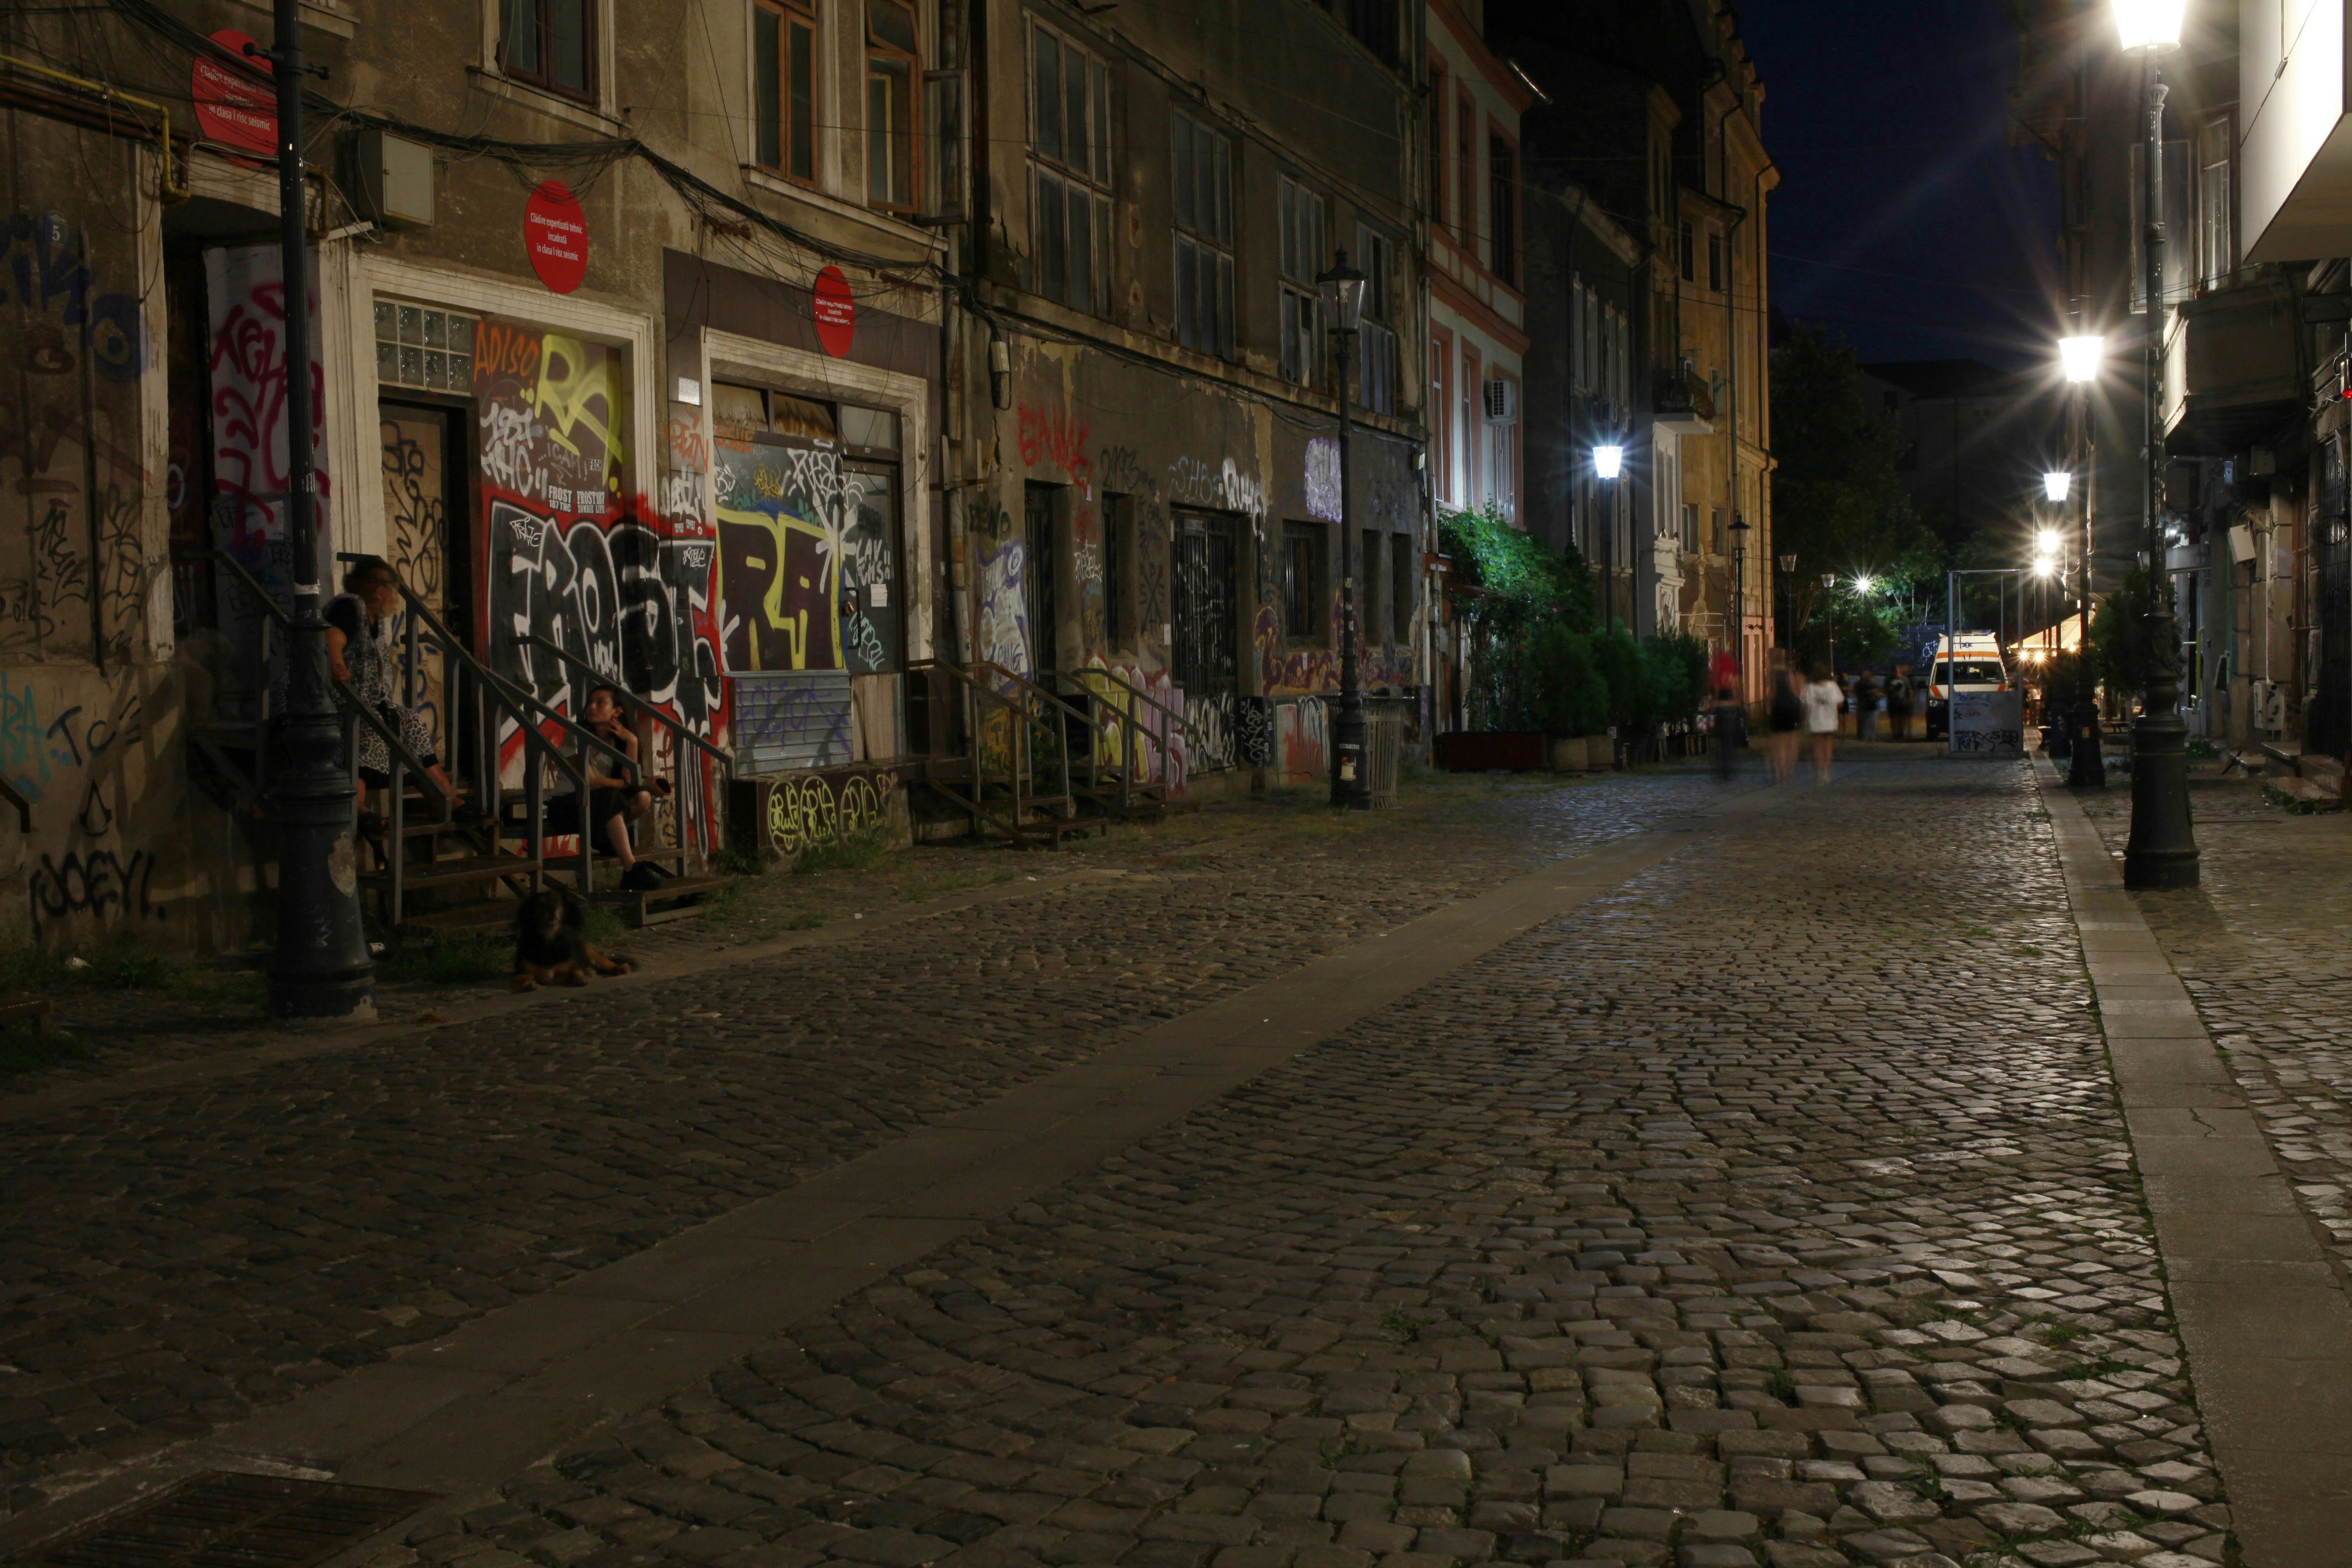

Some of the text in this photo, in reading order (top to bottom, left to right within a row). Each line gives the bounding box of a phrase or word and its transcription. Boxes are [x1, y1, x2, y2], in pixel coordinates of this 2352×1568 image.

[217, 105, 232, 120] clasa
[237, 111, 247, 125] risc
[248, 116, 270, 131] seismic
[531, 213, 582, 234] Clădire expertizată tehnic
[52, 225, 60, 241] 5
[542, 243, 552, 255] clasa
[563, 249, 579, 261] seismic
[549, 485, 572, 504] FROST
[549, 499, 571, 512] 187 THC
